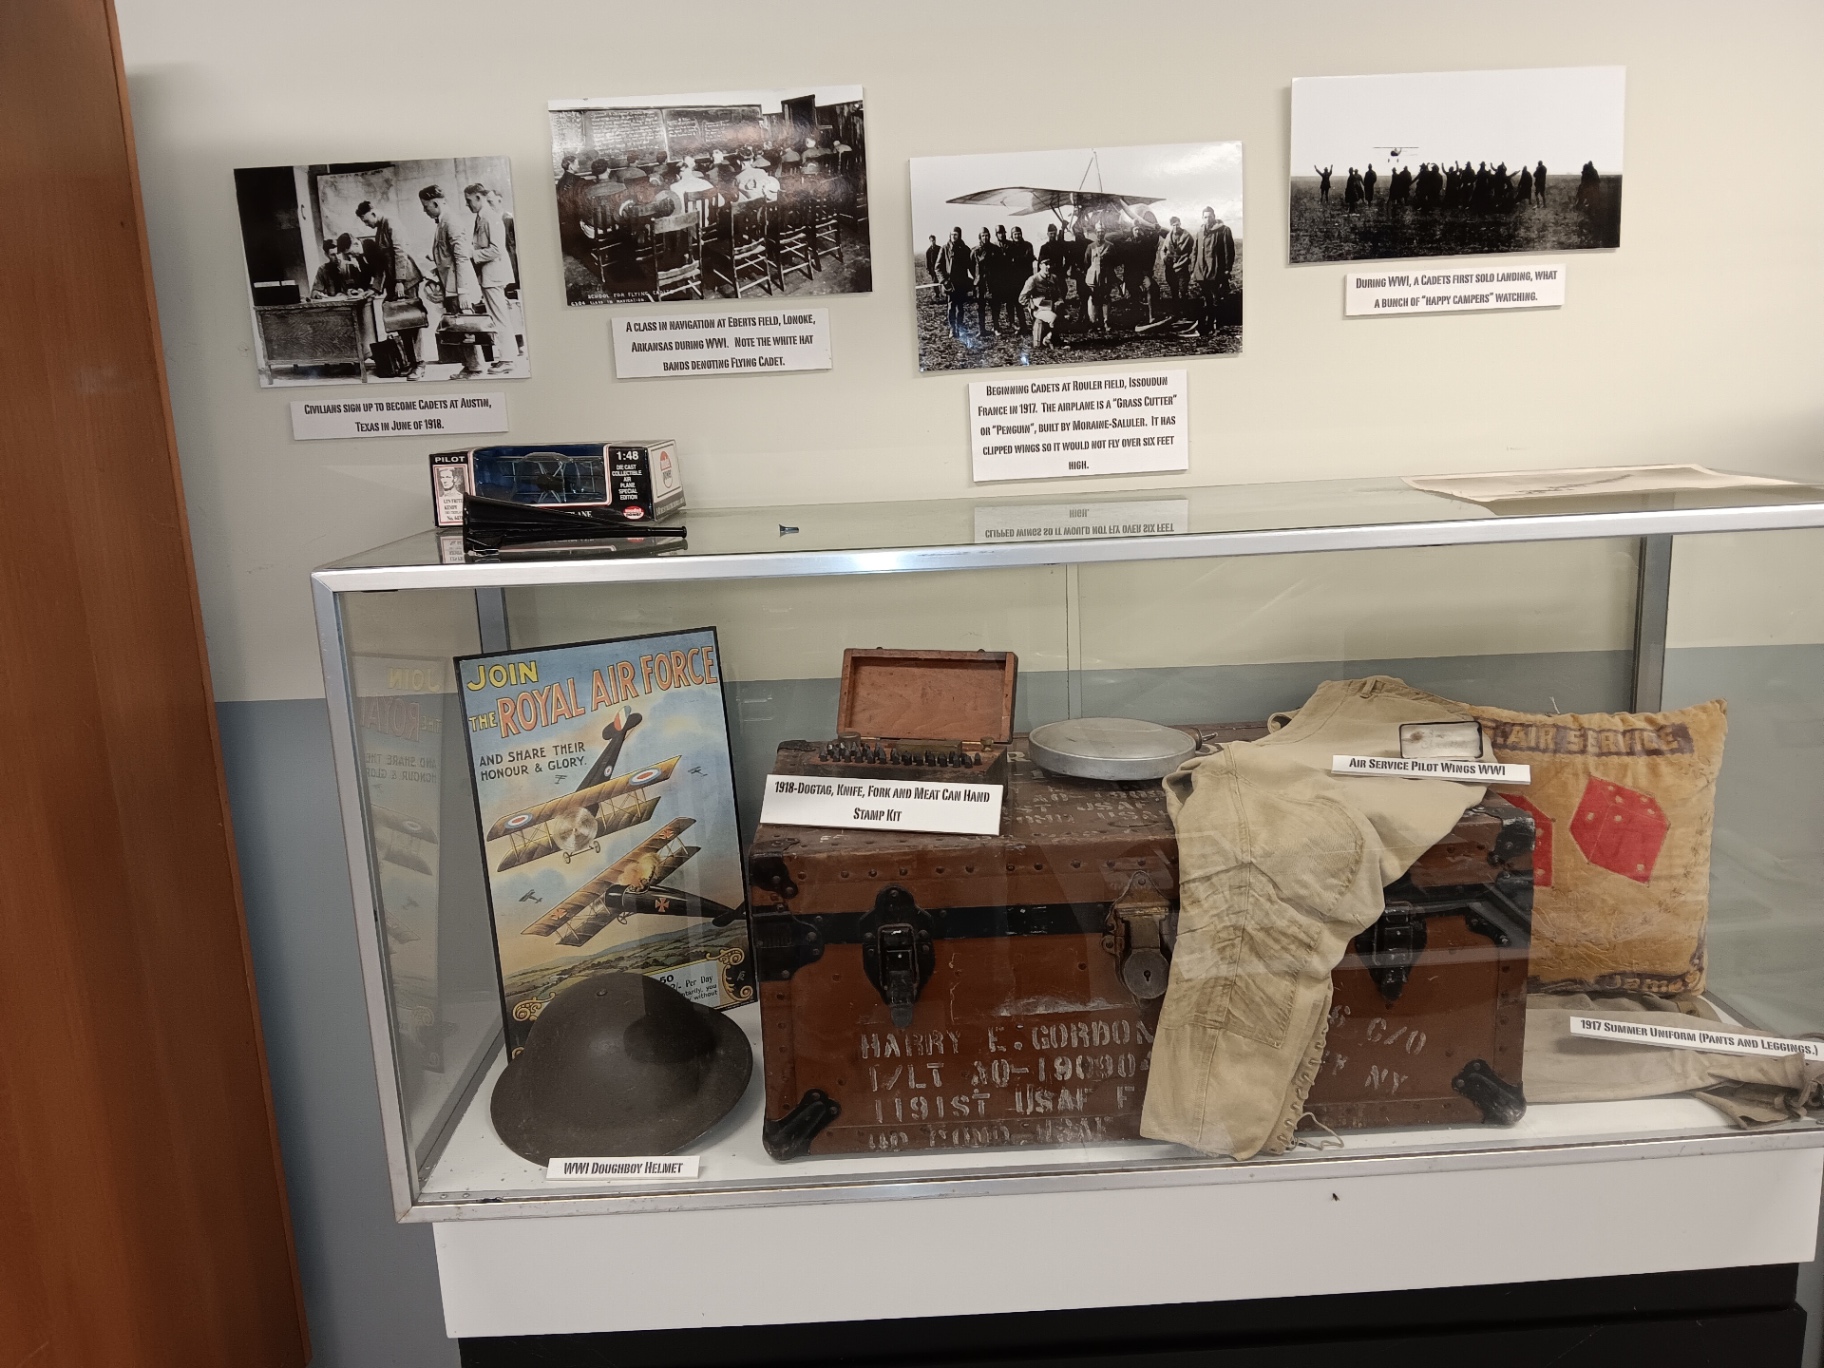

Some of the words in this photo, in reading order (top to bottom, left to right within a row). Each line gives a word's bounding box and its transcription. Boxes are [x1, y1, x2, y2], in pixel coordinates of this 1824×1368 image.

[1356, 277, 1386, 288] DURING
[1388, 275, 1411, 288] WWI,
[1414, 276, 1419, 285] A
[1421, 274, 1450, 286] CADETS
[1453, 274, 1474, 284] FIRST
[1475, 273, 1495, 283] SOLO
[1496, 272, 1532, 283] LANDING,
[1535, 271, 1557, 281] WHAT
[1374, 299, 1380, 309] A
[1382, 297, 1408, 308] BUNCH
[1410, 297, 1420, 306] OF
[1496, 292, 1537, 302] WATCHING.
[626, 322, 632, 333] A
[634, 321, 657, 332] CLASS
[659, 320, 667, 331] IN
[669, 318, 715, 330] NAVIGATION
[717, 318, 726, 328] AT
[728, 316, 756, 327] EBERTS
[758, 315, 781, 327] FIELD,
[783, 314, 815, 326] LONOKE,
[631, 340, 673, 352] ARKANSAS
[675, 340, 704, 351] DURING
[706, 338, 729, 350] WWI.
[735, 336, 755, 348] NOTE
[756, 336, 771, 346] THE
[773, 335, 797, 346] WHITE
[799, 334, 814, 345] HAT
[663, 361, 689, 371] BANDS
[691, 359, 729, 370] DENOTING
[731, 357, 756, 368] FLYING
[759, 356, 785, 367] CADET.
[986, 385, 1029, 396] BEGINNING
[1031, 382, 1060, 394] CADETS
[1062, 382, 1071, 392] AT
[1073, 380, 1102, 392] ROULER
[1104, 379, 1127, 390] FIELD,
[304, 404, 342, 414] CIVILIANS
[344, 403, 361, 413] SIGN
[363, 402, 373, 412] UP
[375, 402, 384, 412] TO
[386, 401, 417, 411] BECOME
[419, 400, 448, 410] CADETS
[450, 399, 458, 409] AT
[460, 398, 492, 409] AUSTIN,
[978, 405, 1008, 416] FRANCE
[1009, 406, 1017, 414] IN
[1020, 403, 1037, 414] 1917.
[1042, 402, 1056, 413] THE
[1058, 401, 1095, 412] AIRPLANE
[1096, 400, 1104, 410] IS
[1106, 400, 1111, 409] A
[356, 421, 379, 432] TEXAS
[381, 422, 389, 431] IN
[391, 420, 412, 432] JUNE
[414, 420, 422, 430] OF
[424, 418, 444, 430] 1918.
[980, 426, 991, 436] OR
[1039, 422, 1059, 433] BUILT
[1061, 422, 1070, 432] BY
[1151, 416, 1159, 427] IT
[1161, 415, 1176, 426] HAS
[983, 446, 1012, 456] CLIPPED
[1014, 444, 1040, 454] WINGS
[1042, 443, 1051, 452] SO
[1053, 442, 1060, 451] IT
[1062, 441, 1089, 451] WOULD
[1091, 439, 1106, 449] NOT
[1108, 439, 1120, 449] FLY
[1122, 438, 1141, 448] OVER
[1143, 437, 1156, 446] SIX
[1157, 436, 1174, 446] FEET
[617, 451, 639, 460] 1:48
[1069, 461, 1089, 470] HIGH.
[466, 660, 539, 691] JOIN
[469, 710, 498, 732] THE
[497, 678, 586, 738] ROYAL
[591, 660, 639, 712] AIR
[640, 646, 718, 695] FORCE
[480, 754, 503, 767] AND
[508, 747, 546, 762] SHARE
[552, 742, 586, 756] THEIR
[480, 765, 529, 781] HONOUR
[535, 764, 543, 772] &
[548, 756, 587, 770] GLORY.
[1349, 758, 1366, 768] AIR
[1369, 758, 1409, 771] SERVICE
[1411, 761, 1439, 772] PILOT
[1441, 762, 1476, 774] WINGS
[1478, 763, 1506, 776] WWI
[775, 781, 834, 797] 1918-DOGTAG,
[837, 784, 865, 798] KNIFE,
[868, 785, 890, 798] FORK
[893, 788, 911, 799] AND
[914, 788, 940, 800] MEAT
[942, 790, 961, 801] CAN
[963, 790, 990, 803] HAND
[853, 808, 884, 821] STAMP
[886, 808, 902, 822] KIT
[686, 979, 696, 987] Per
[694, 990, 717, 999] without
[861, 1030, 960, 1058] HARRY
[1032, 1019, 1154, 1050] GORDON
[1581, 1019, 1601, 1031] 1917
[1604, 1022, 1648, 1037] SUMMER
[1650, 1027, 1696, 1042] UNIFORM
[1699, 1032, 1734, 1046] (PANTS
[1738, 1038, 1758, 1049] AND
[1761, 1039, 1818, 1056] LEGGINGS.)
[564, 1162, 589, 1174] WWI
[591, 1162, 642, 1174] DOUGHBOY
[644, 1162, 683, 1173] HELMET
